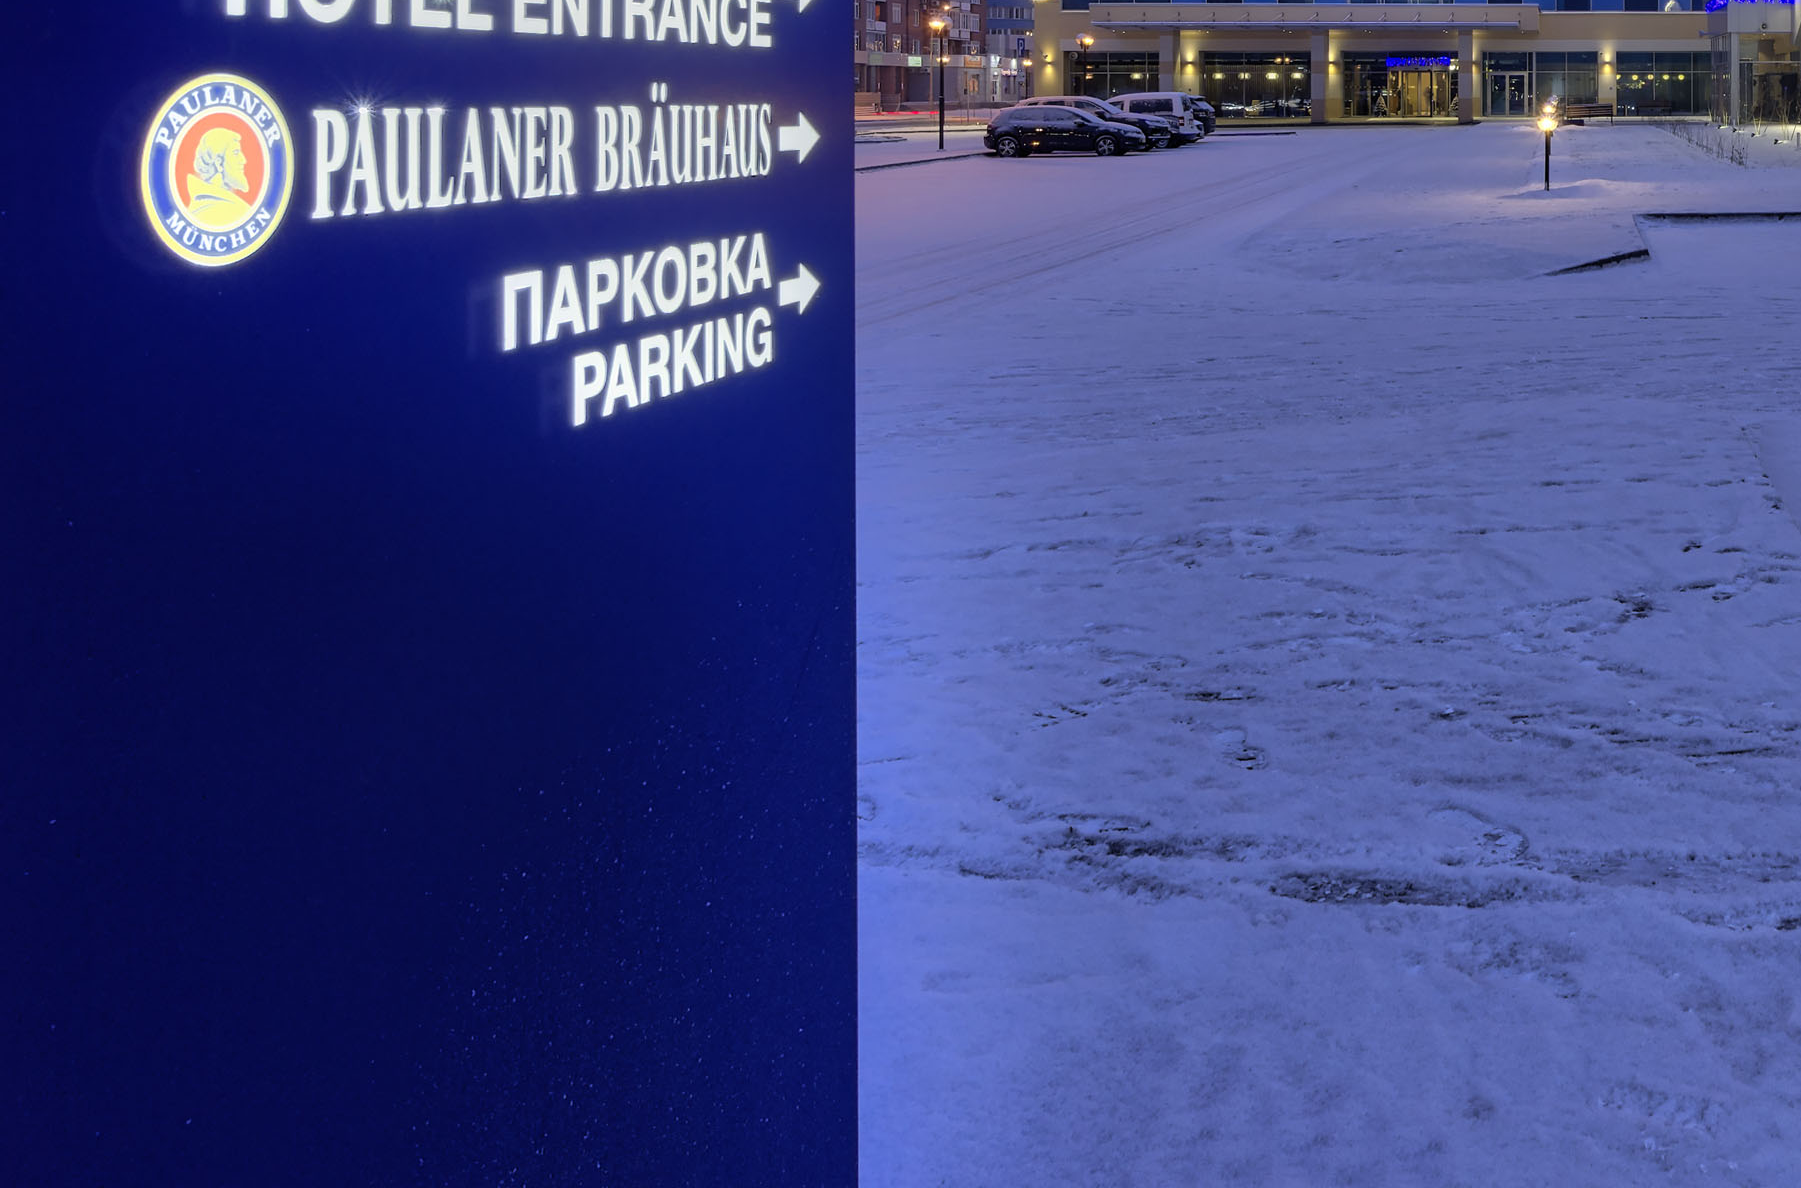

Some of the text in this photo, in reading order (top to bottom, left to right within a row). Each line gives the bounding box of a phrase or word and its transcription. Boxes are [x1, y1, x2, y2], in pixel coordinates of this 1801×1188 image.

[155, 85, 281, 149] PAULANER
[311, 83, 773, 219] PAULANER BRÄUHAUS
[166, 207, 272, 253] MÜNCHEN
[502, 232, 773, 352] ПАРКОВКА
[572, 307, 773, 427] PARKING
